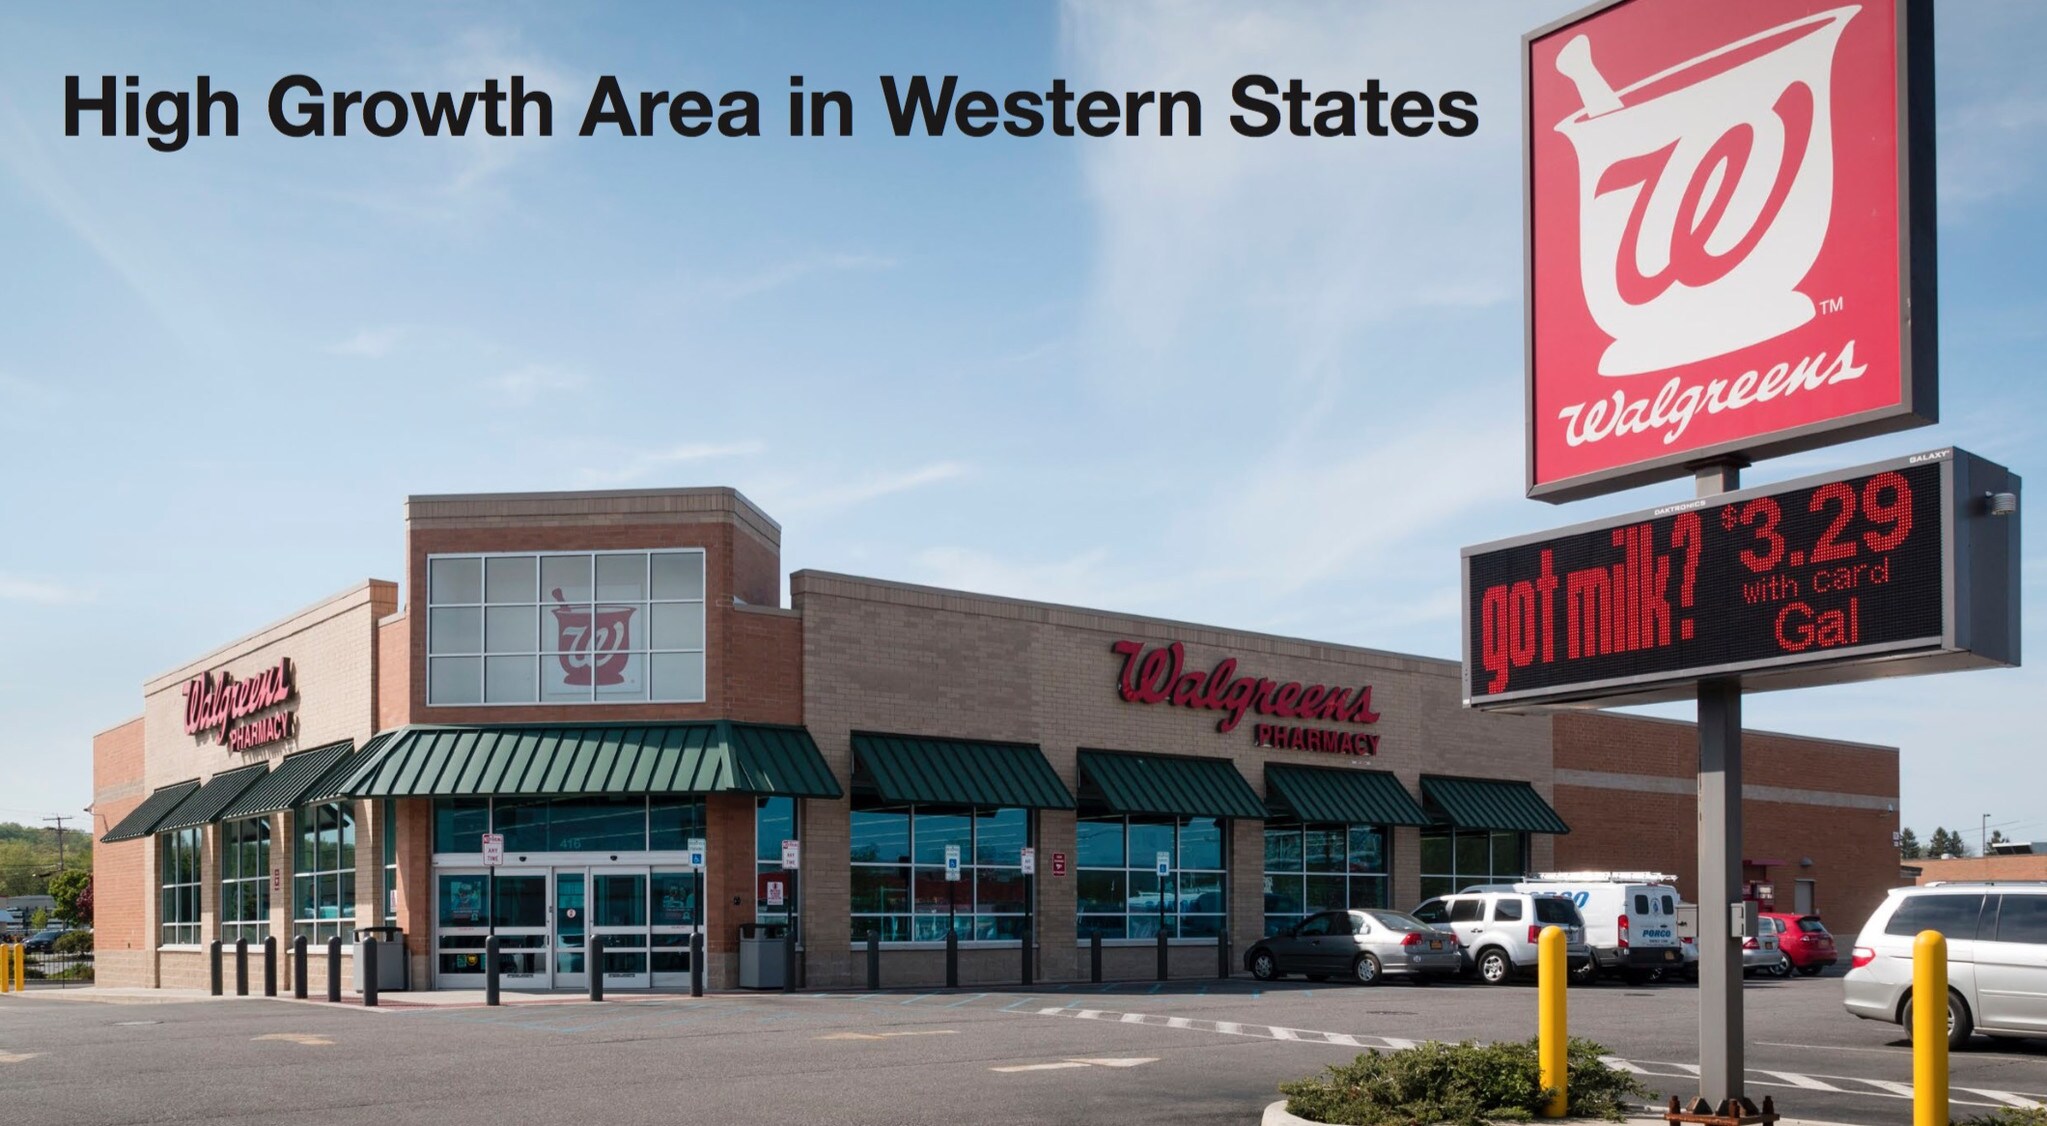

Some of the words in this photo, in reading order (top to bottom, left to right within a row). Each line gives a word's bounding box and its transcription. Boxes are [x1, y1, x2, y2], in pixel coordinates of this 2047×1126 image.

[1820, 297, 1843, 316] TM
[1558, 339, 1868, 445] Walgreens
[1654, 499, 1706, 516] DAKTRONICS
[1721, 471, 1913, 574] $3.29
[1482, 549, 1559, 695] got
[1566, 511, 1702, 660] milk?
[1743, 574, 1799, 604] with
[1812, 555, 1890, 594] card
[1775, 597, 1859, 652] Gal
[182, 657, 291, 746] Walgreens
[1112, 640, 1381, 733] Walgreens
[229, 710, 291, 752] PHARMACY
[1256, 723, 1381, 756] PHARMACY
[1642, 929, 1671, 938] PORCO
